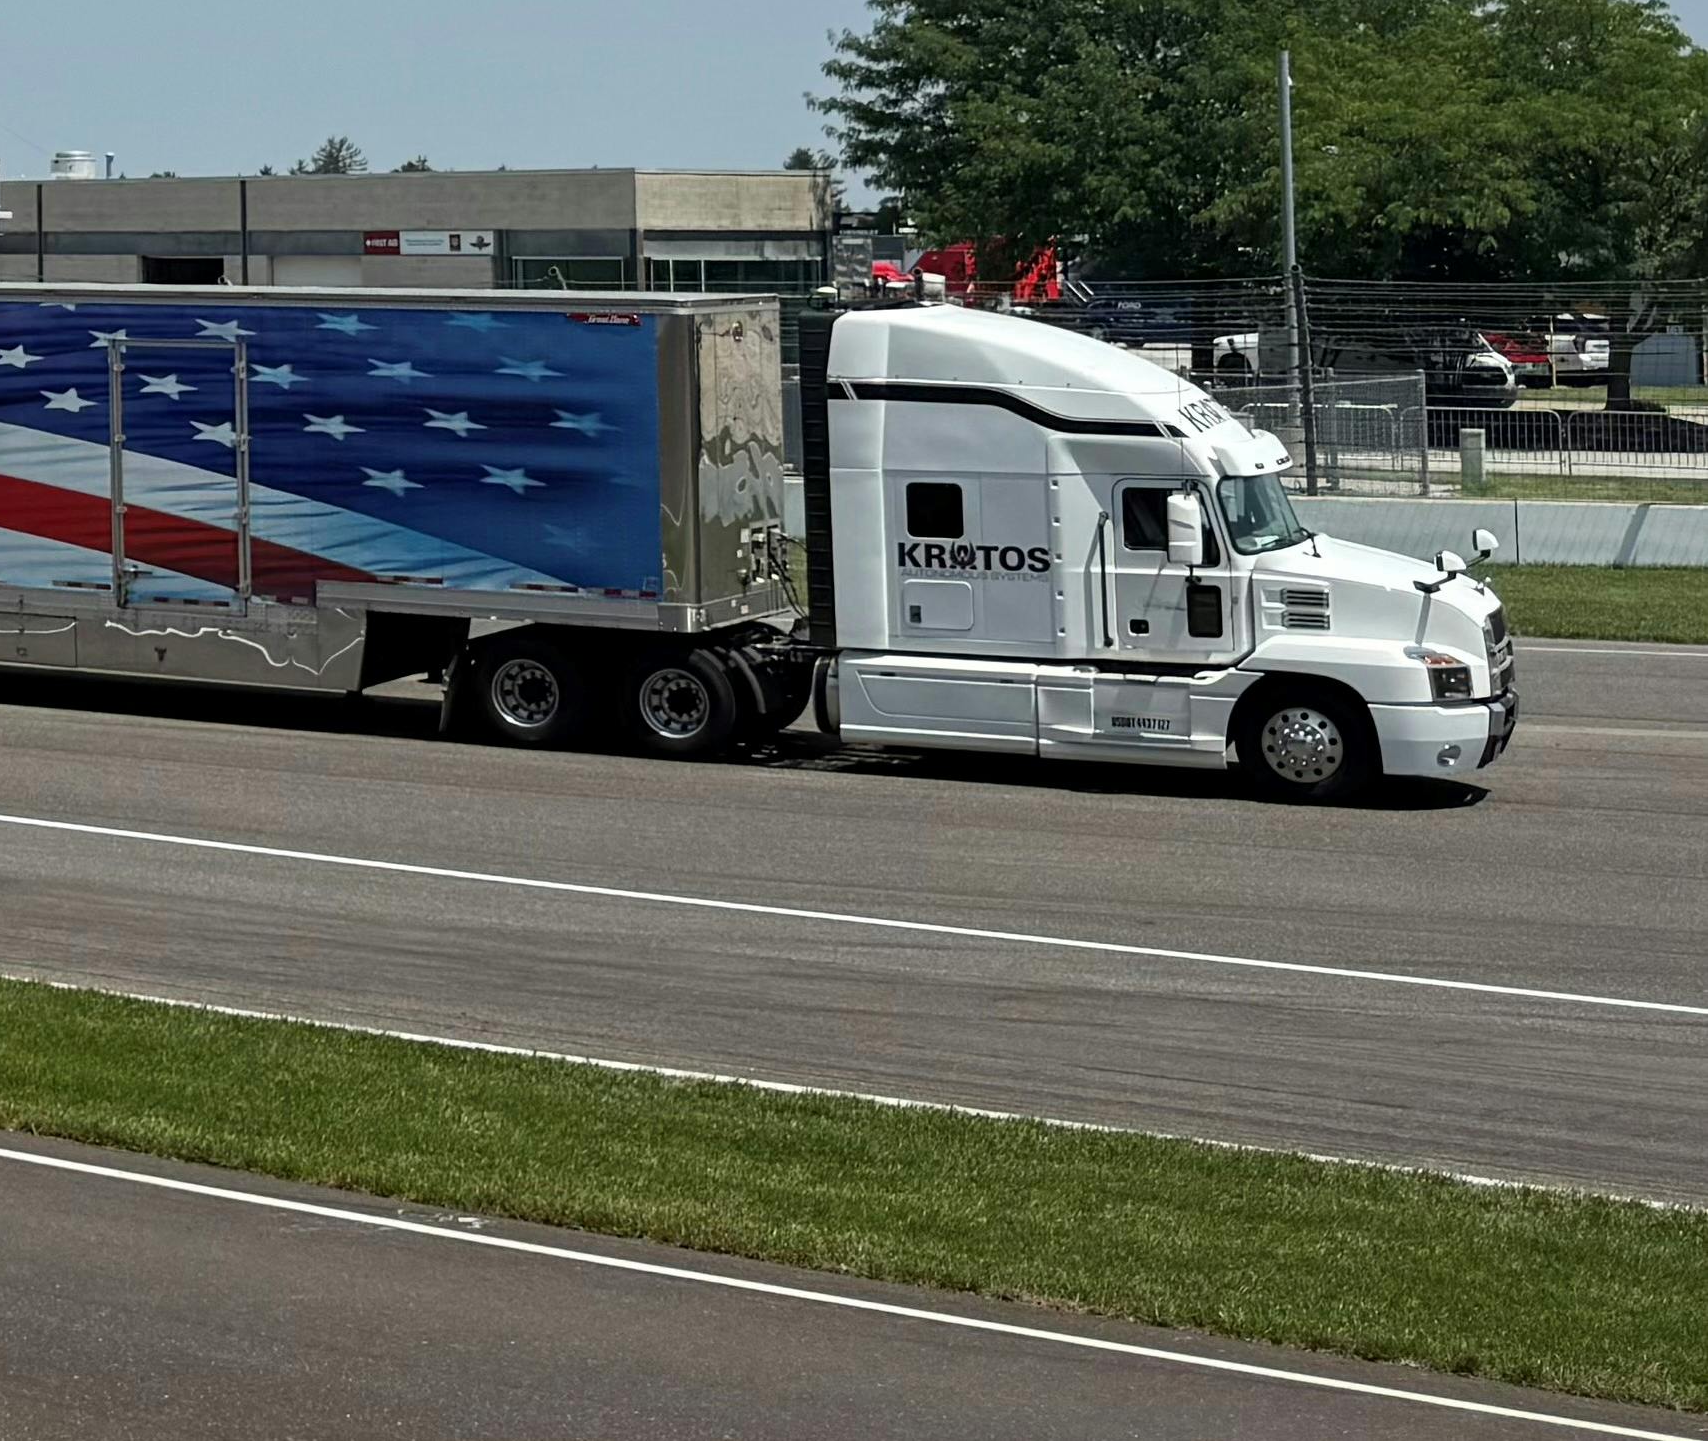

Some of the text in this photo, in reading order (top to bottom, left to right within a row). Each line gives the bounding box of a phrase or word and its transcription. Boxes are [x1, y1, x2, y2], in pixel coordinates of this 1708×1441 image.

[897, 541, 1052, 573] KRATOS
[900, 568, 1050, 583] AUTONOMOUS SYSTEMS
